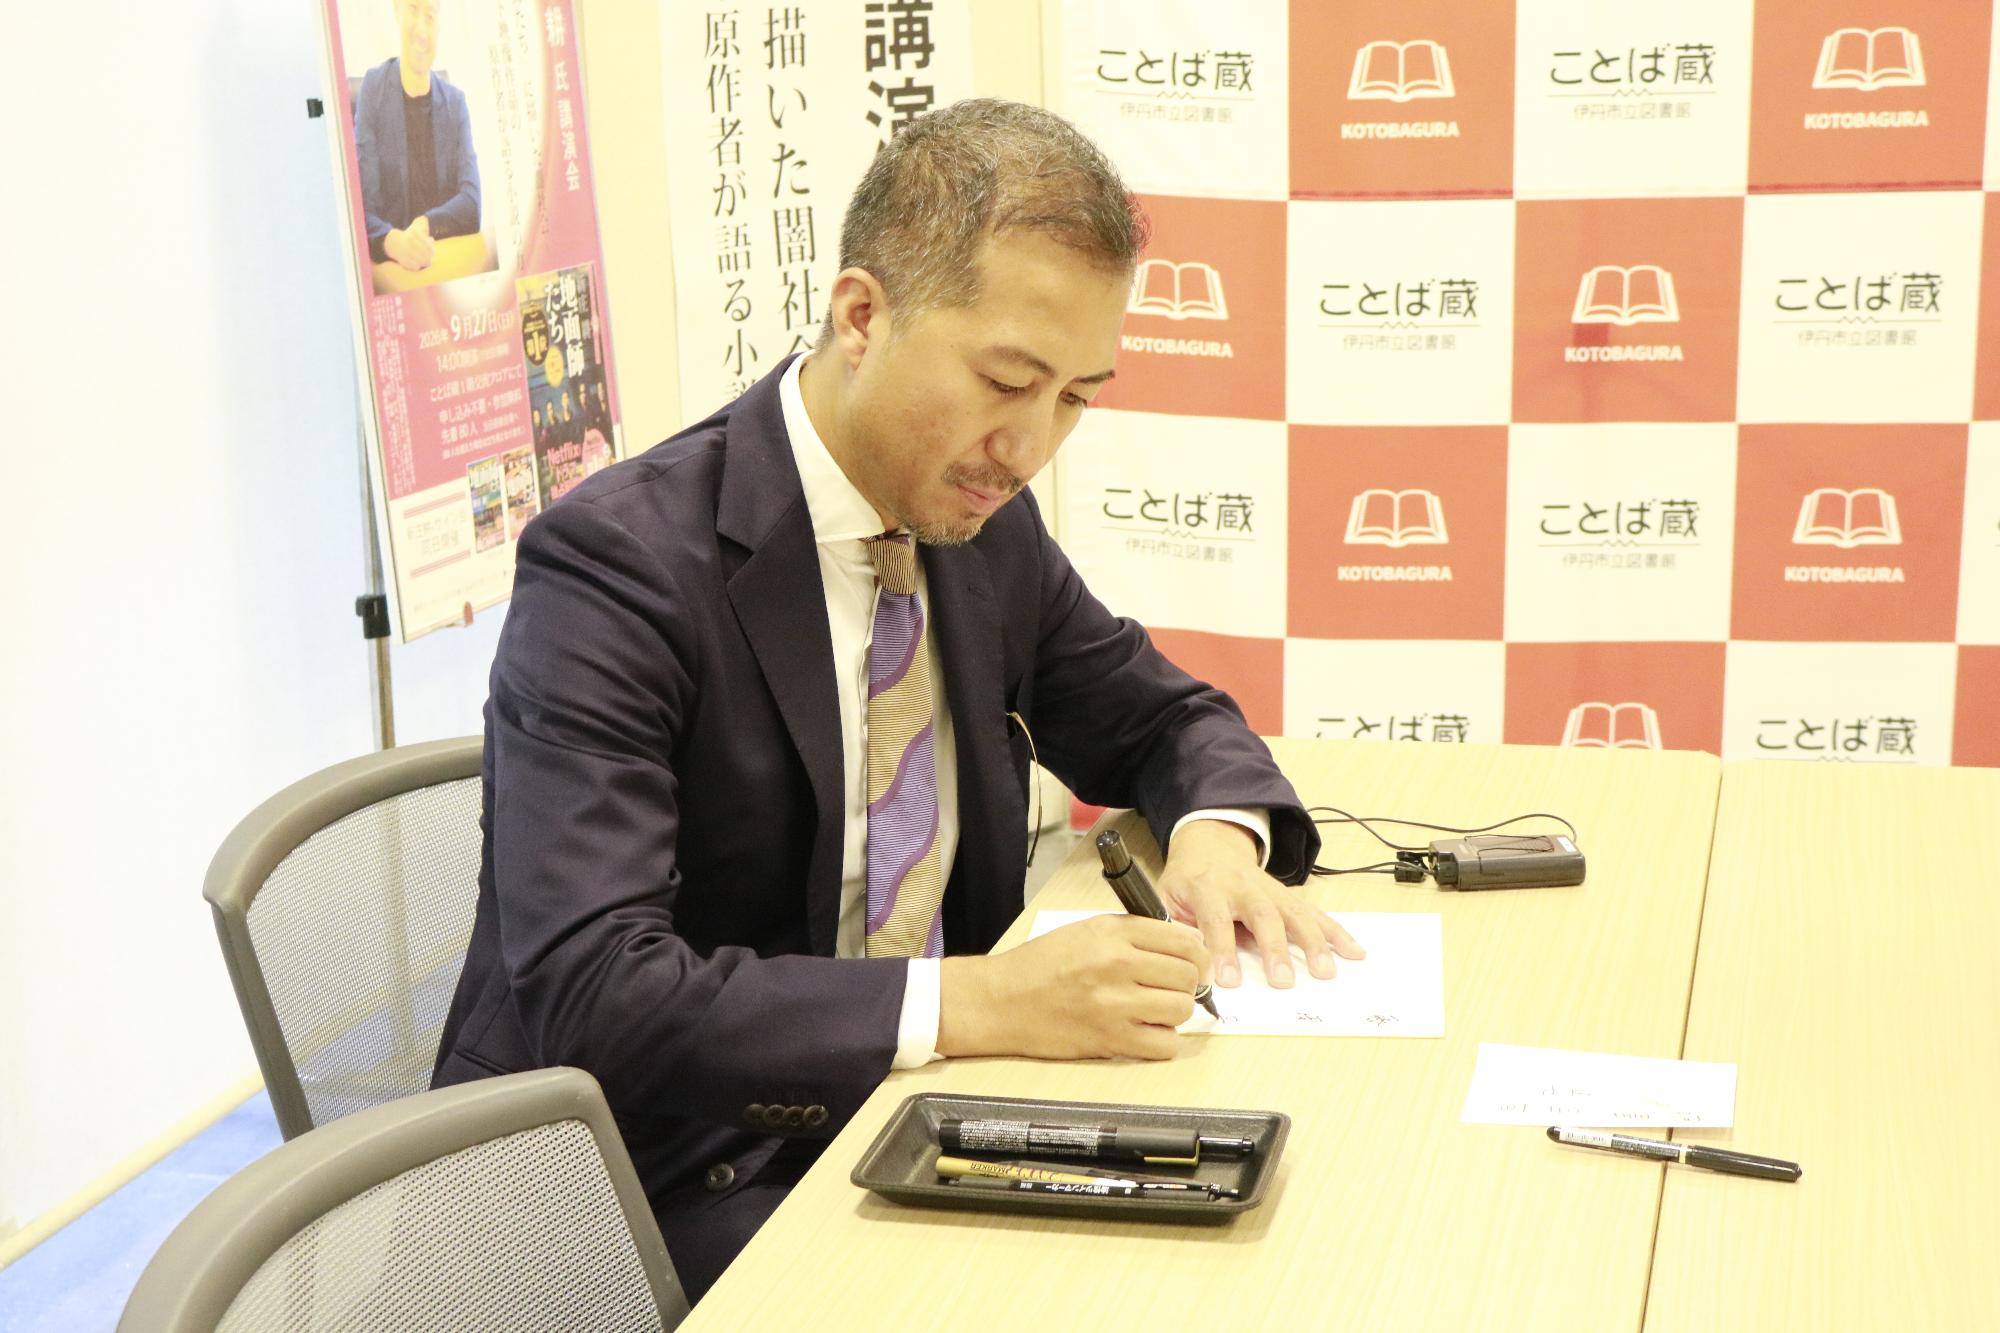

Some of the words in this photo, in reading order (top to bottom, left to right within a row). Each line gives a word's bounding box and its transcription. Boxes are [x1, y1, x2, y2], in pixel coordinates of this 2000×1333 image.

[1097, 49, 1254, 91] ことば蔵
[1550, 43, 1716, 85] ことば蔵
[1120, 102, 1232, 124] 伊丹市立図書館
[1573, 101, 1691, 120] 伊丹市立図書館
[1804, 111, 1929, 129] KOTOBAGURA
[1341, 122, 1460, 140] KOTOBAGURA
[1320, 279, 1479, 318] ことば蔵
[1776, 272, 1943, 313] ことば蔵
[544, 281, 564, 344] たち
[559, 272, 585, 378] 地面師
[1121, 335, 1234, 358] KOTOBAGURA
[1564, 345, 1684, 362] KOTOBAGURA
[1103, 488, 1255, 531] ことば蔵
[1540, 499, 1699, 537] ことば蔵
[1125, 537, 1234, 563] 伊丹市立図書館
[1337, 565, 1453, 582] KOTOBAGURA
[1783, 566, 1905, 583] KOTOBAGURA
[1755, 716, 1918, 755] ことば蔵
